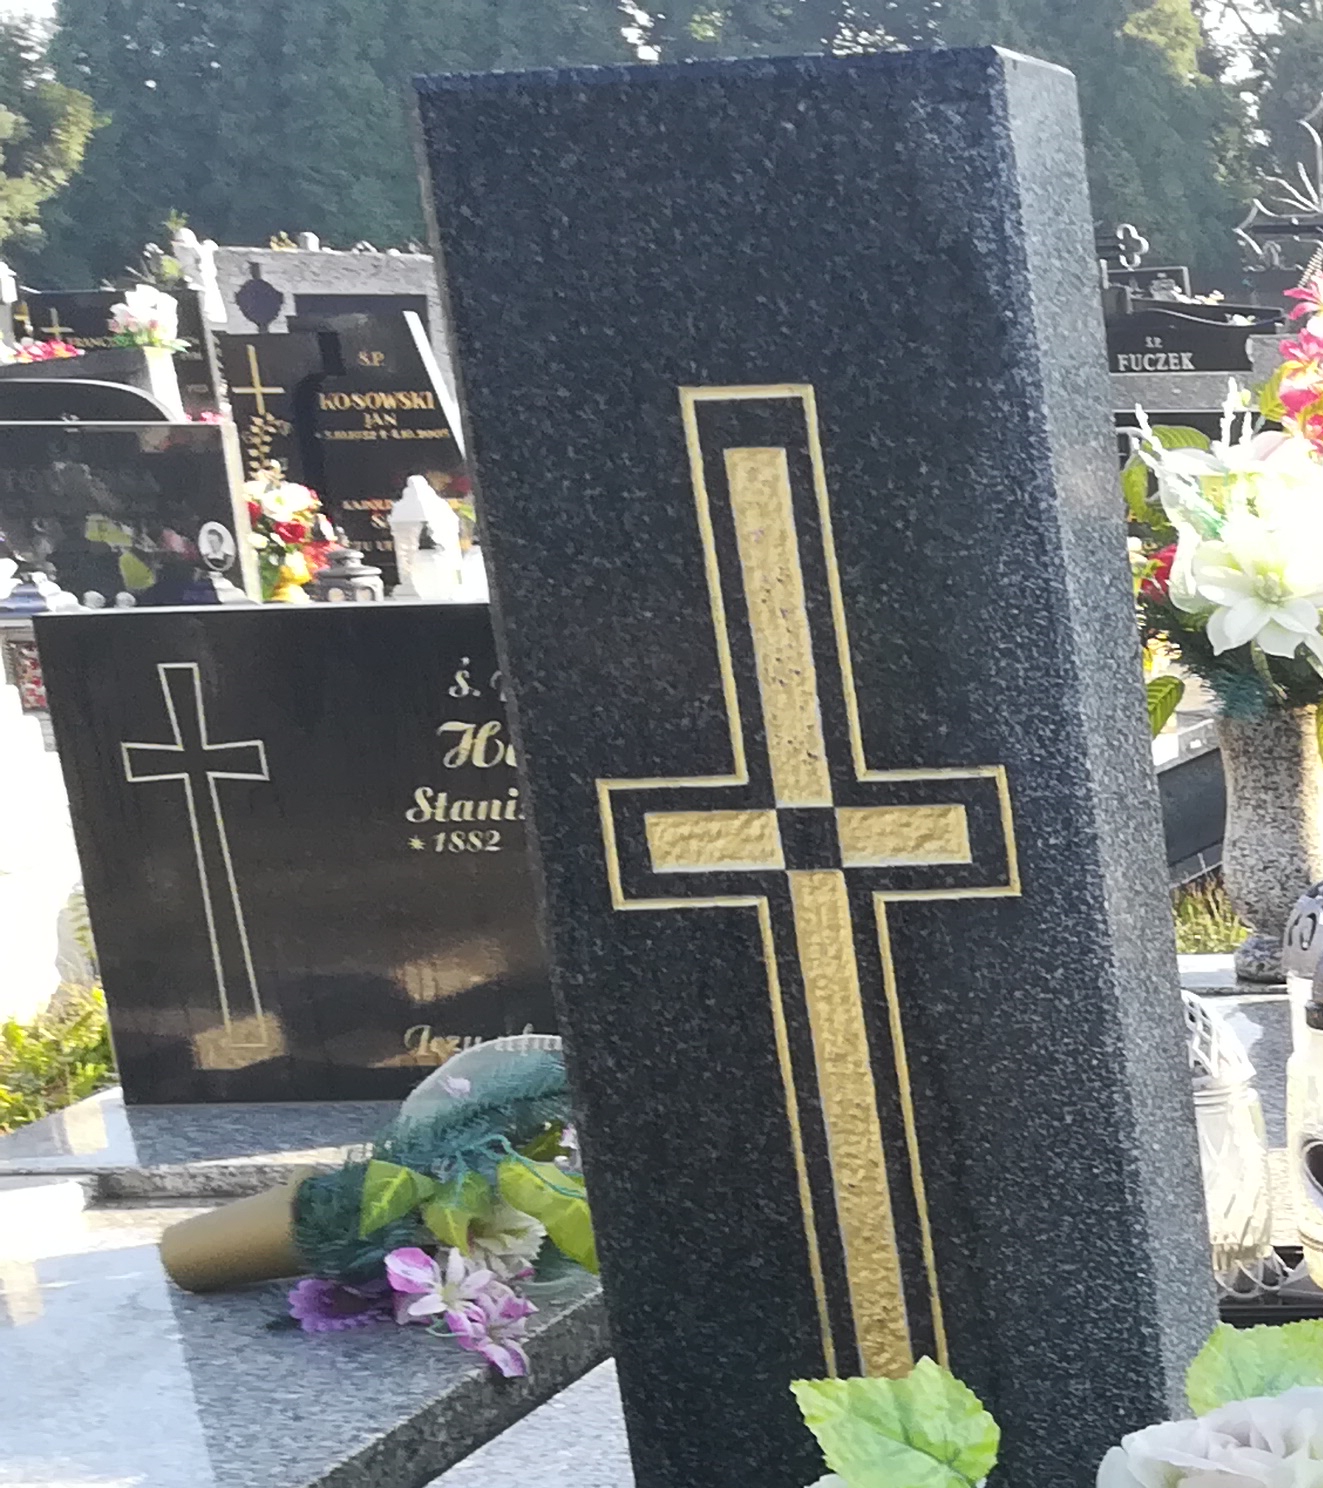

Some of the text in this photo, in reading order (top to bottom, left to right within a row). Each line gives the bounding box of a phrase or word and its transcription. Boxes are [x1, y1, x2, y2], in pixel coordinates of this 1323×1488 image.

[1117, 352, 1196, 371] FUCZEK
[318, 389, 436, 411] KOSOWSKI
[405, 786, 526, 823] Stani
[433, 829, 502, 853] 1882
